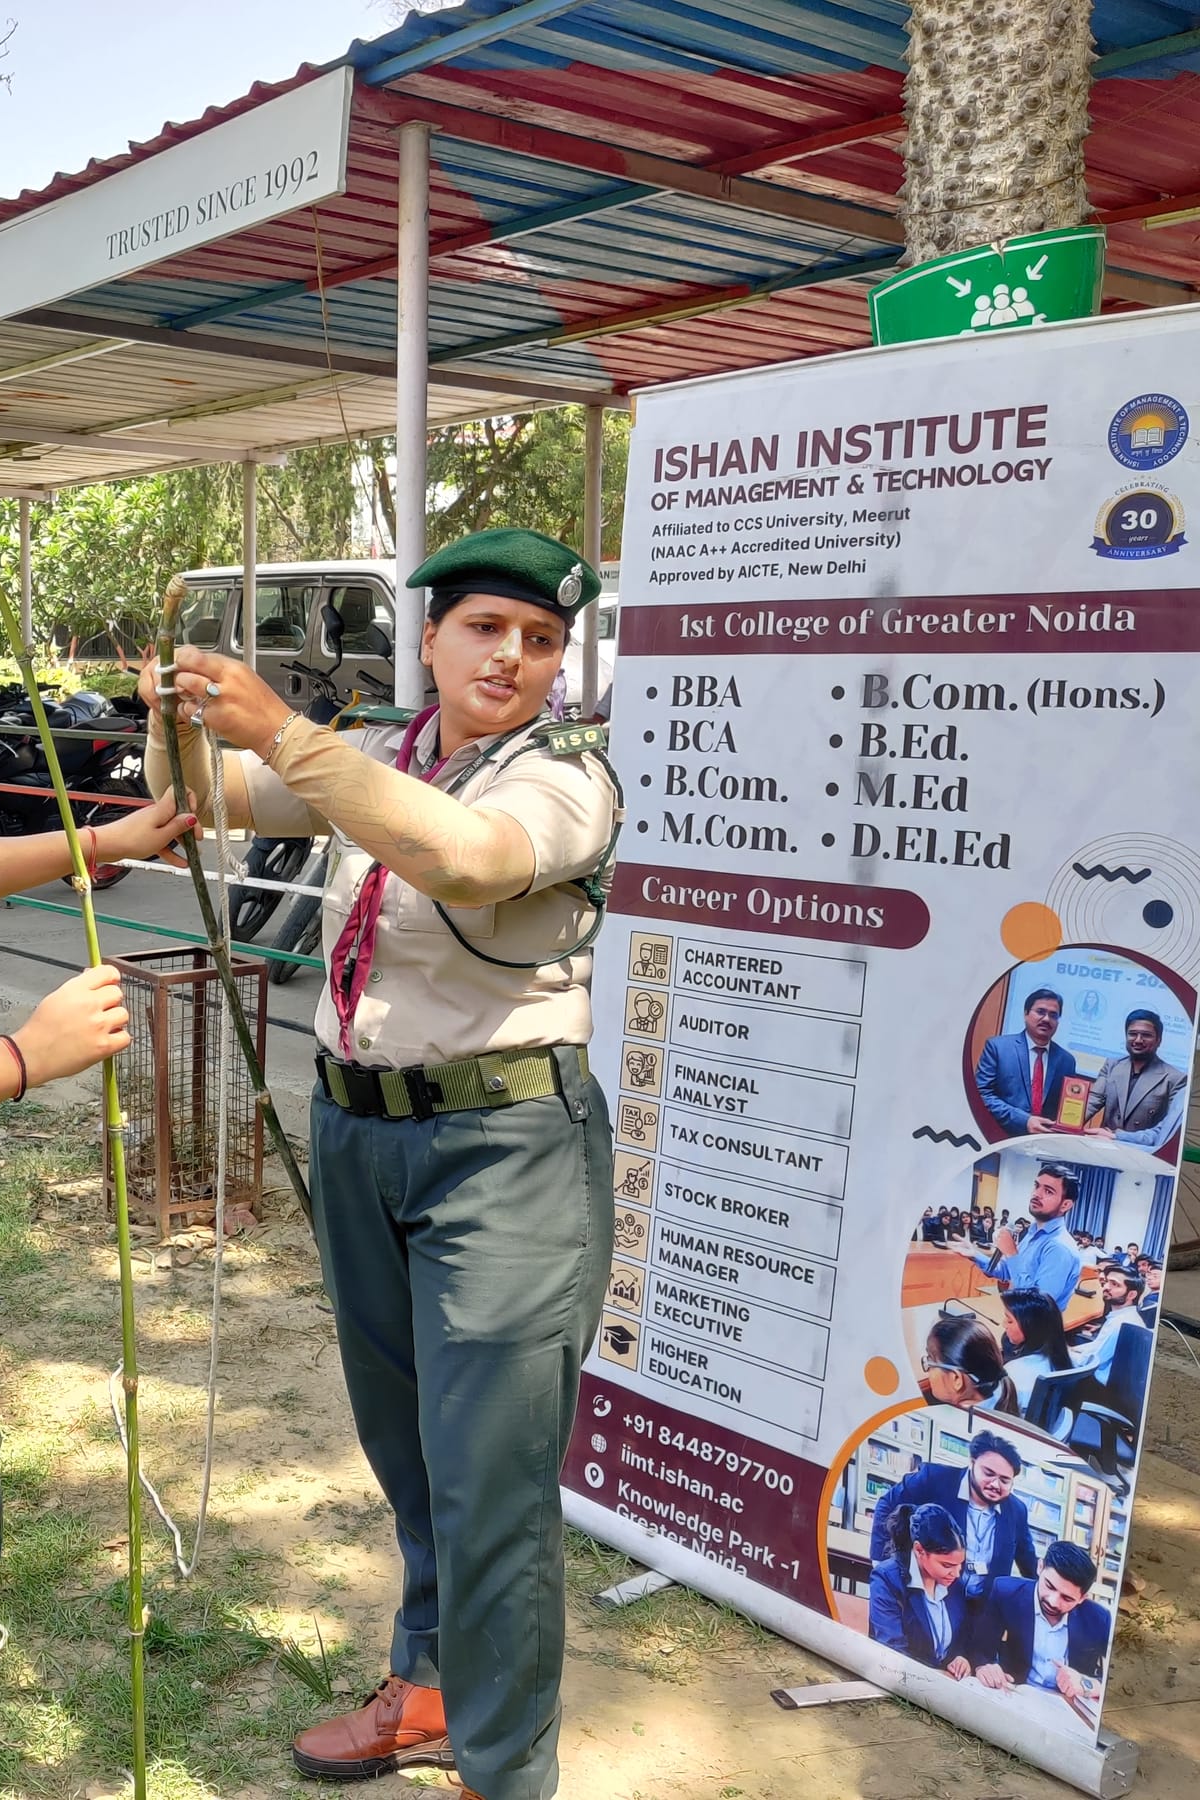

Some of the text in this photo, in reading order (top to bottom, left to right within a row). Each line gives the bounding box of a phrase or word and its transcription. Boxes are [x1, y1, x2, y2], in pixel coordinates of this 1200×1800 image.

[106, 150, 320, 261] TRUSTED SINCE 1992
[653, 405, 1049, 483] ISHAN INSTITUTE
[651, 458, 1053, 511] OF MANAGEMENT & TECHNOLOGY
[1114, 481, 1170, 496] CELEBRATING
[652, 506, 911, 537] Affiliated to CCS University, Meerut
[1121, 509, 1157, 530] 30
[650, 530, 902, 561] (NAAC A++ Accredited University)
[1107, 546, 1168, 557] ANNIVERSARY
[649, 558, 867, 586] Approved by AICTE, New Delhi
[679, 604, 1135, 642] 1st College of Greater Noida
[671, 675, 741, 708] BBA
[552, 730, 598, 750] HSG
[667, 720, 738, 754] BCA
[859, 723, 969, 762] B.Ed.
[664, 765, 788, 803] B.Com.
[854, 771, 968, 812] M.Ed
[660, 811, 798, 854] M.Com.
[850, 823, 1011, 870] D.El.Ed
[641, 876, 884, 929] Career Options
[684, 948, 783, 975] CHARTERED
[1056, 962, 1123, 983] BUDGET
[681, 970, 801, 1001] ACCOUNTANT
[678, 1014, 750, 1041] AUDITOR
[674, 1065, 760, 1095] FINANCIAL
[673, 1085, 749, 1114] ANALYST
[669, 1124, 824, 1172] TAX CONSULTANT
[664, 1182, 790, 1228] STOCK BROKER
[658, 1248, 740, 1286] MANAGER
[660, 1227, 815, 1284] HUMAN RESOURCE
[655, 1281, 751, 1323] MARKETING
[653, 1300, 743, 1343] EXECUTIVE
[650, 1336, 709, 1370] HIGHER
[648, 1358, 742, 1404] EDUCATION
[623, 1412, 794, 1496] +91 8448797700
[620, 1444, 745, 1514] iimt.ishan.ac
[617, 1479, 724, 1544] Knowledge
[729, 1529, 775, 1569] Park
